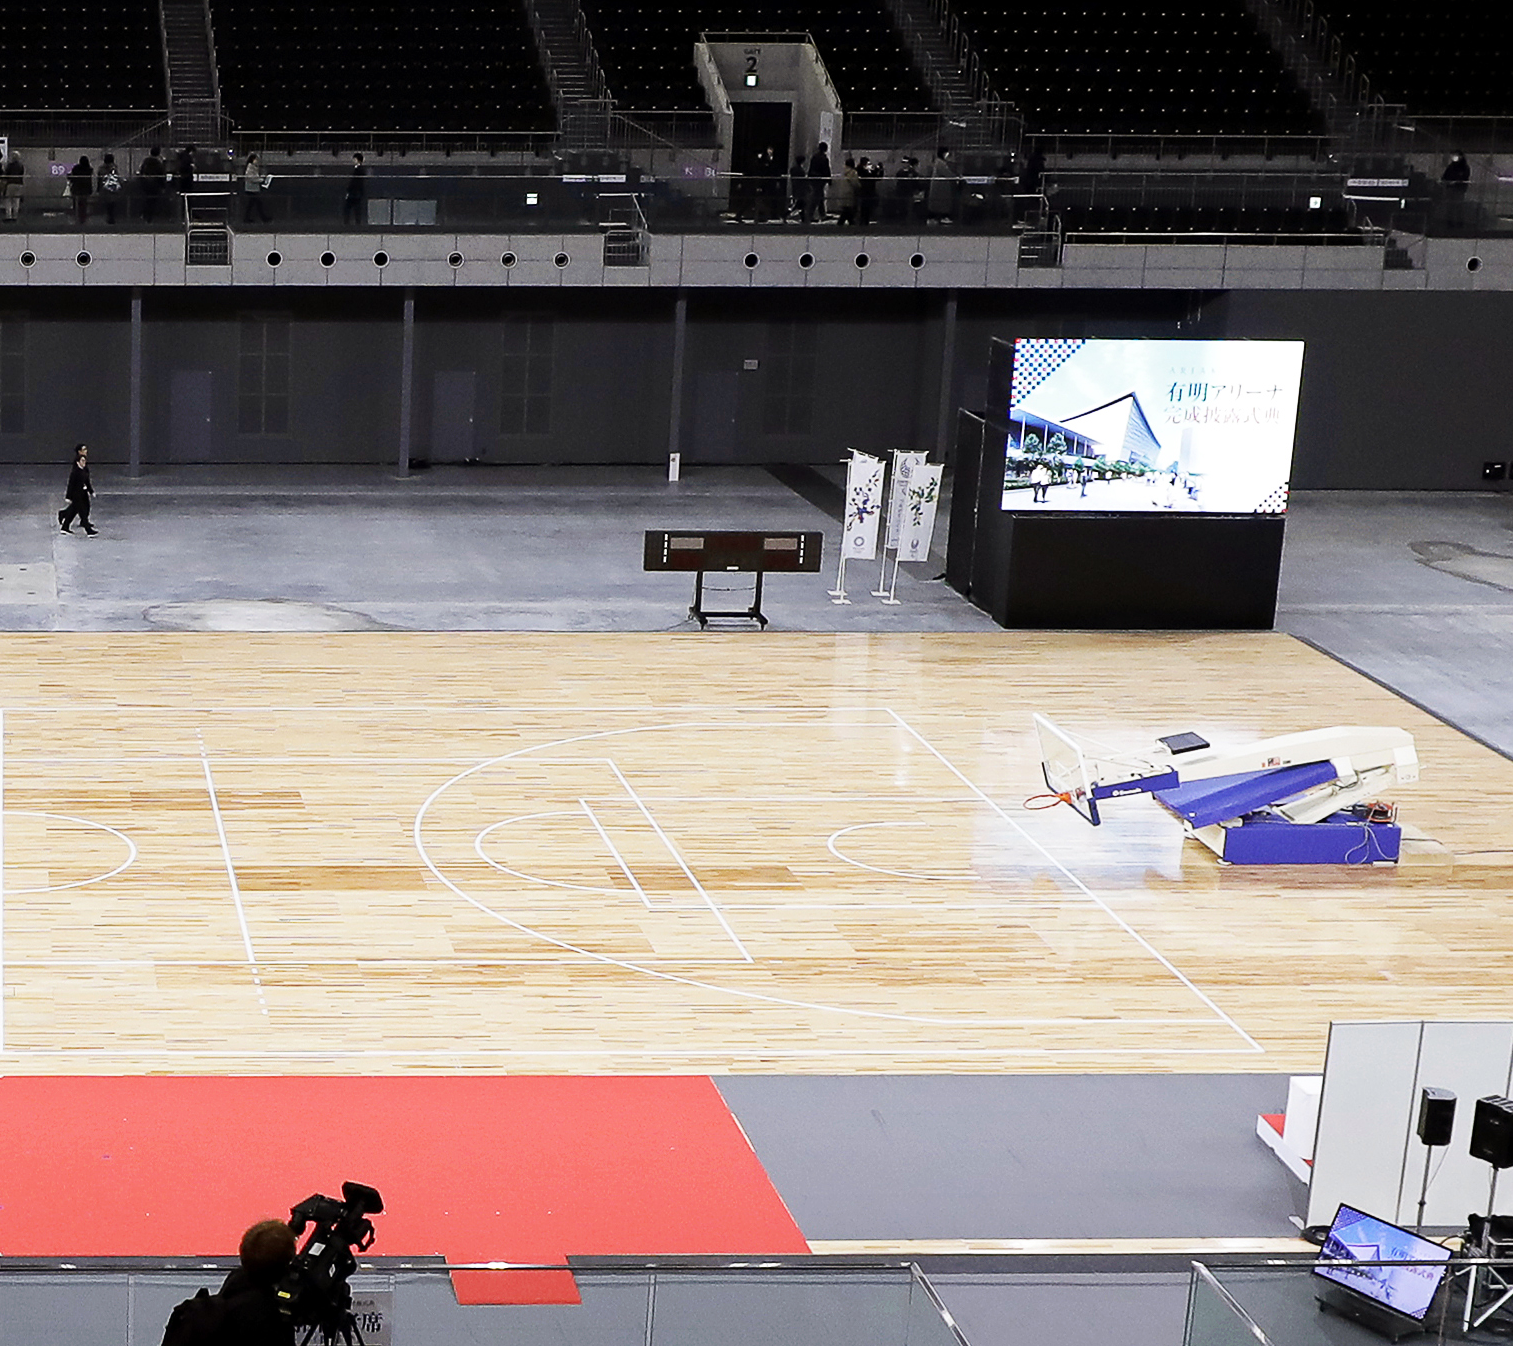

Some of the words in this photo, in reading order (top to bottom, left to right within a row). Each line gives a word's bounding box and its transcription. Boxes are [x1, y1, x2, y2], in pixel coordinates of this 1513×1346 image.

[746, 56, 758, 73] 2
[1166, 381, 1284, 402] 有明アリーナ
